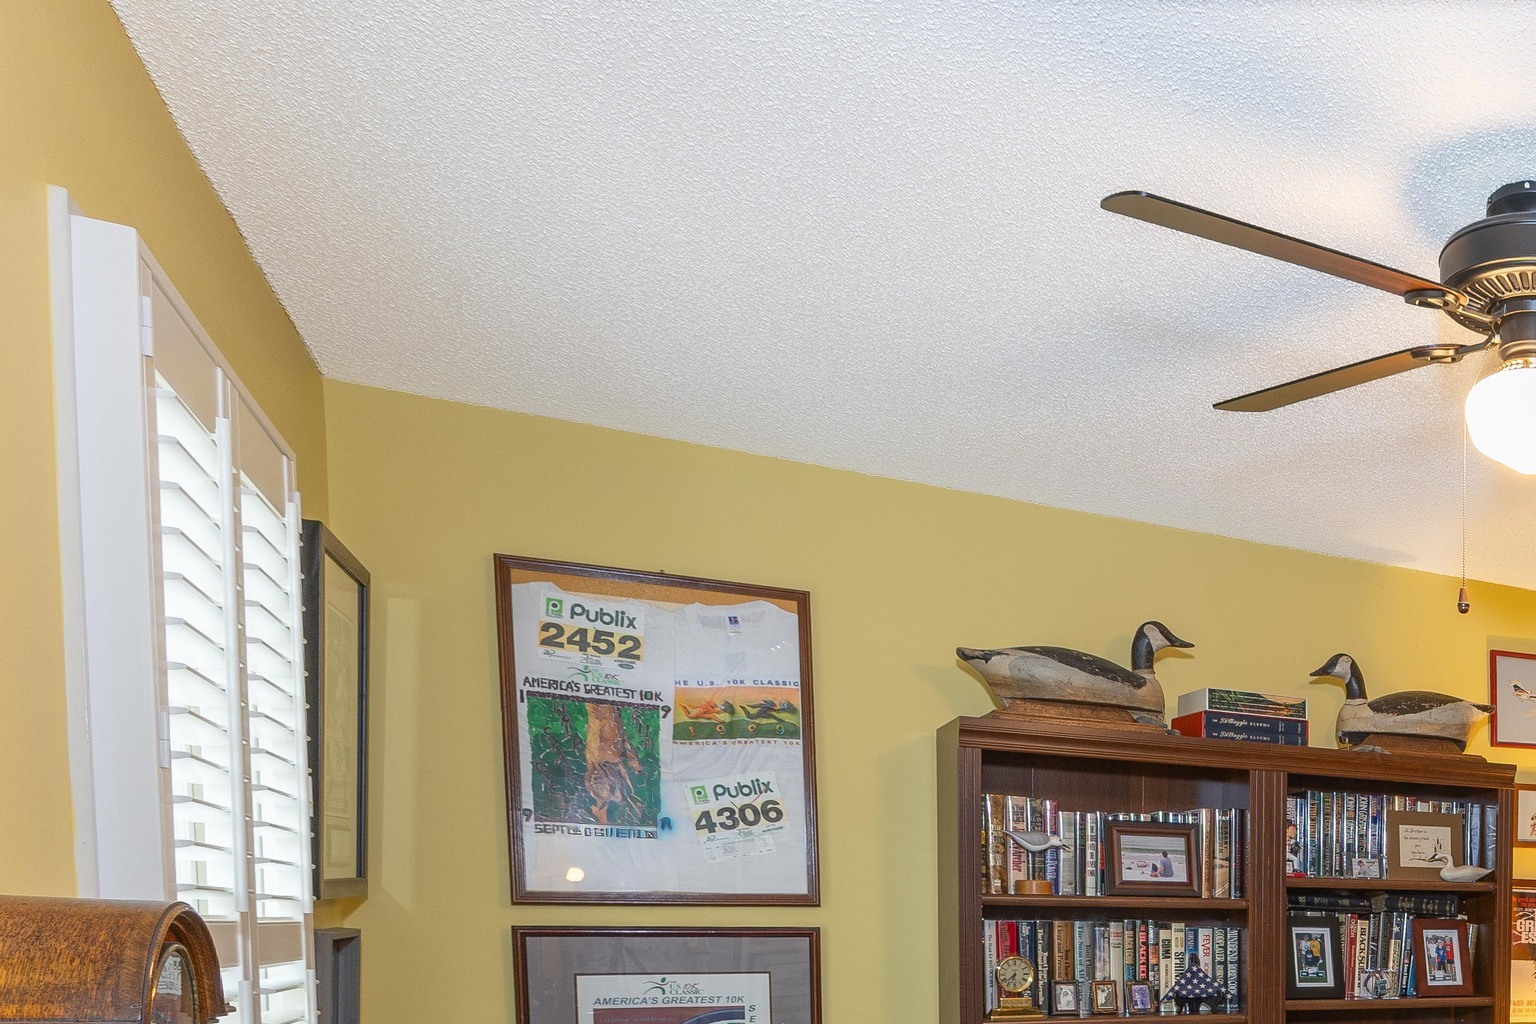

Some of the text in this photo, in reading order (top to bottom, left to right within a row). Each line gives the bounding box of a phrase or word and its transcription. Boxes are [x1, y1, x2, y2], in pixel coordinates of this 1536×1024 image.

[570, 603, 637, 629] Publix
[538, 622, 642, 661] 2452
[523, 676, 664, 702] AMERICA'S GREATEST 10K
[753, 679, 800, 687] CLASSIC
[714, 780, 774, 802] Publix
[695, 799, 784, 834] 4306
[1013, 850, 1025, 872] Archer
[1139, 932, 1147, 979] BLACK ICE
[1162, 939, 1171, 959] COMA
[1201, 934, 1210, 957] FEVER
[1228, 929, 1238, 961] MINDBEND
[593, 995, 745, 1006] AMERICA'S GREATEST 10K
